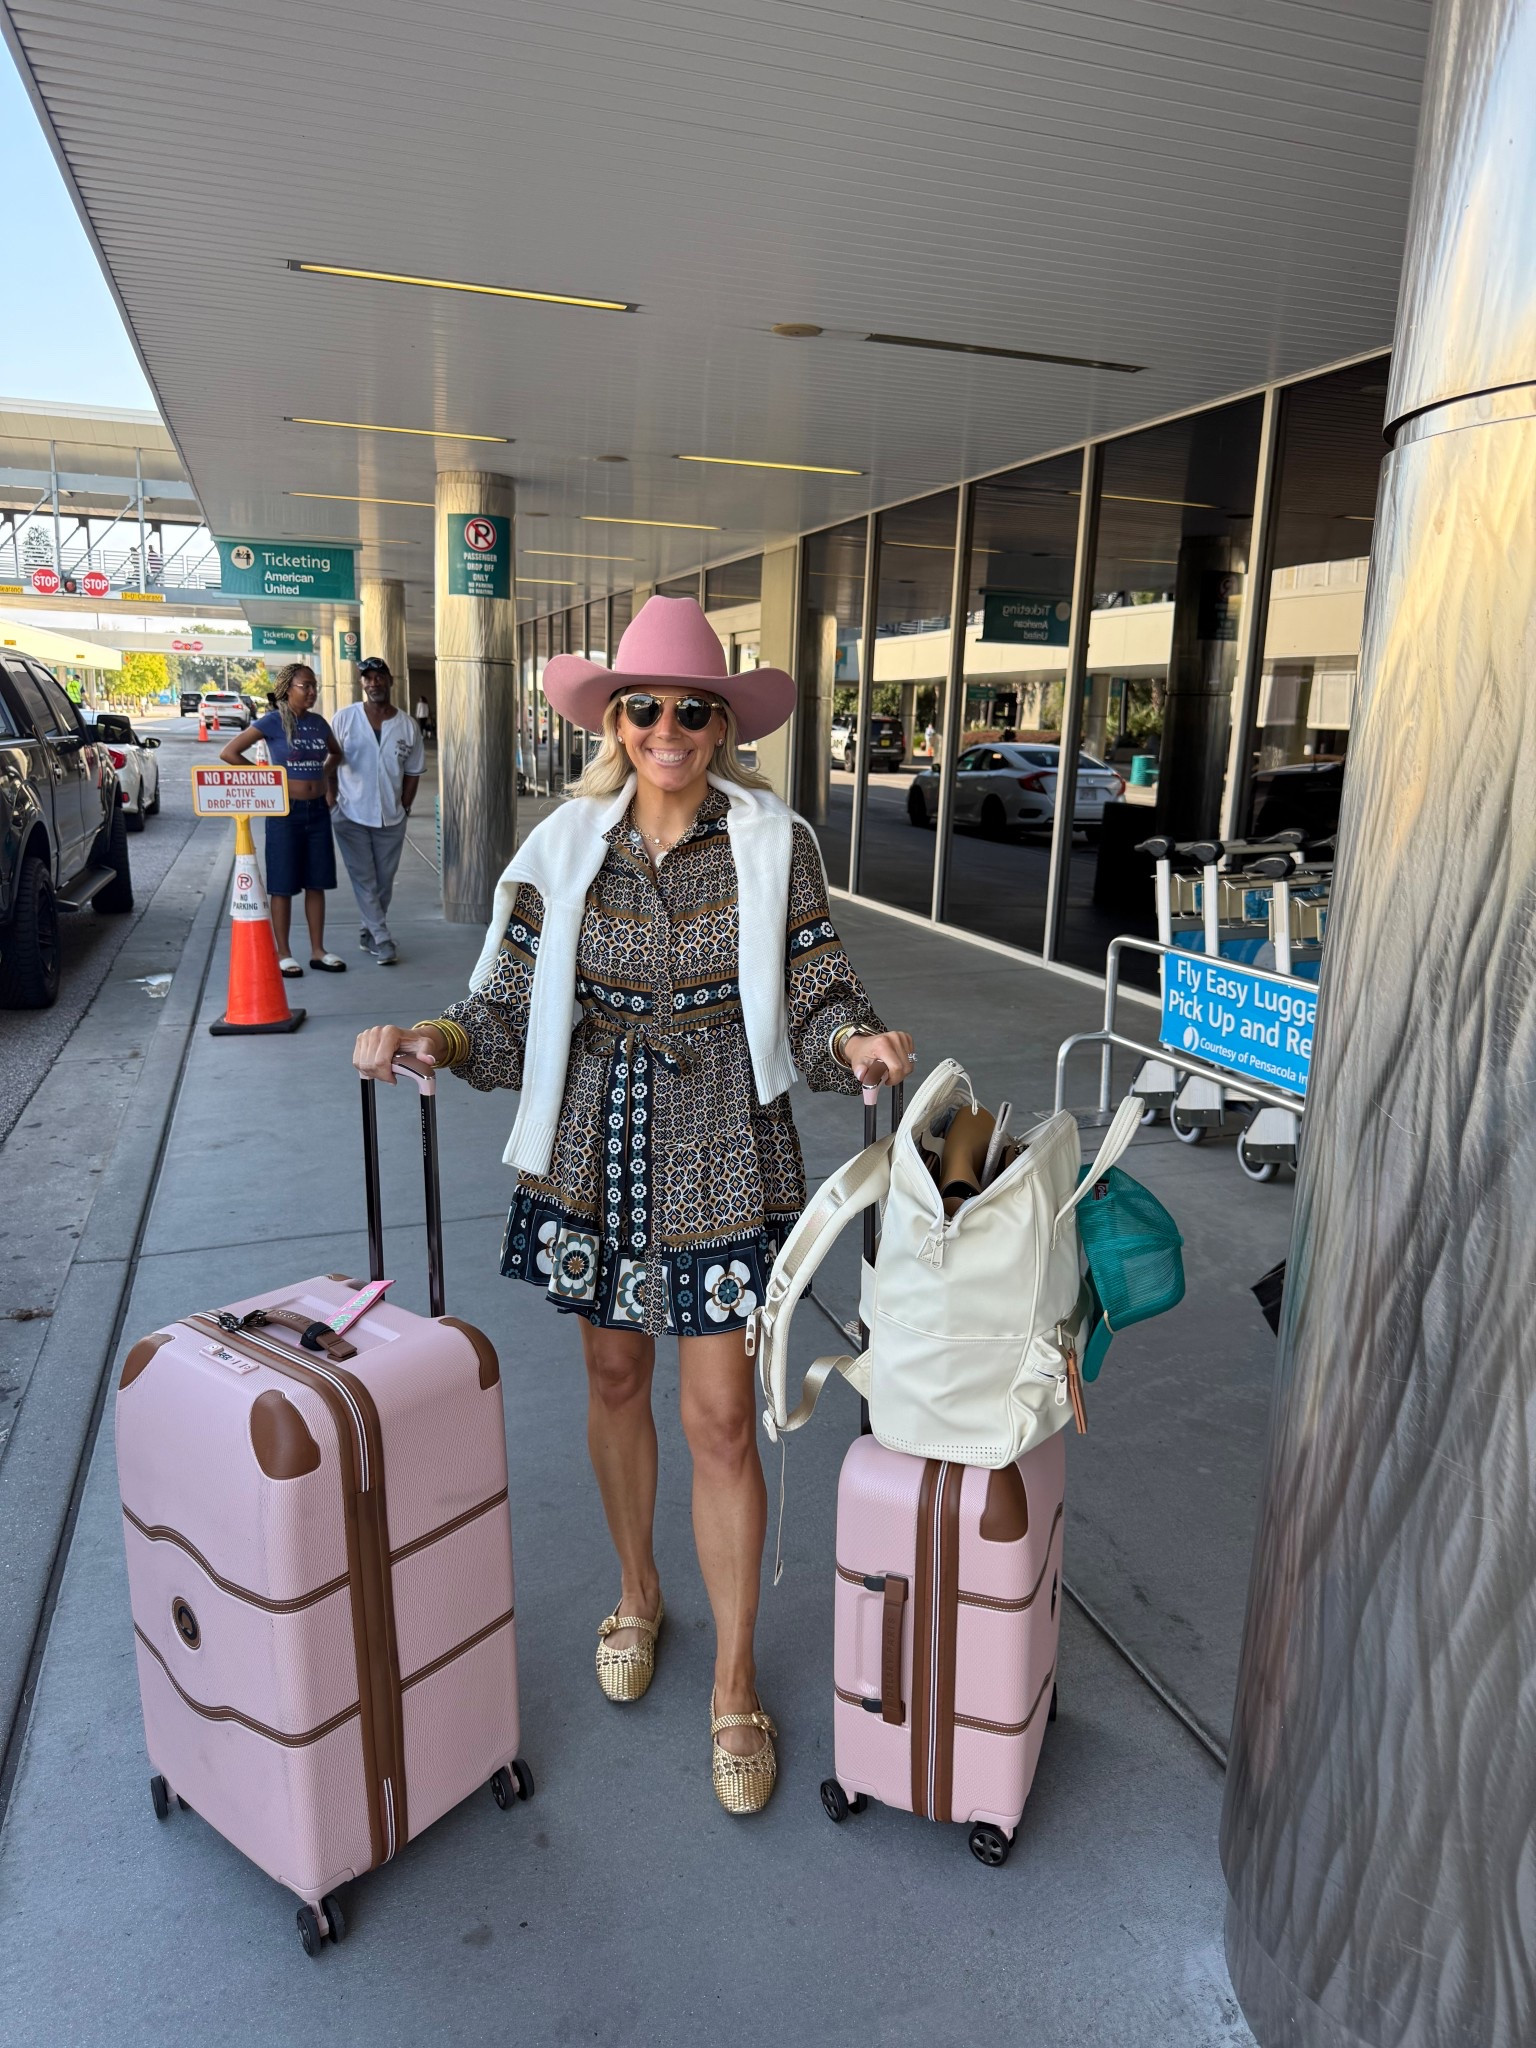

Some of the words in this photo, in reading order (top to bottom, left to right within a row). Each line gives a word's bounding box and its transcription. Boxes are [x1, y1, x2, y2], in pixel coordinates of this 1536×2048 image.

[262, 552, 330, 573] Ticketing
[463, 552, 497, 562] PASSENGER
[467, 562, 483, 571] DROP
[484, 563, 494, 572] OFF
[33, 575, 59, 587] STOP
[264, 571, 314, 583] American
[473, 573, 489, 582] ONLY
[84, 579, 108, 590] STOP
[264, 583, 299, 595] United
[262, 630, 295, 640] Ticketing
[203, 771, 220, 785] NO
[223, 771, 276, 785] PARKING
[226, 788, 256, 798] ACTIVE
[207, 799, 252, 809] DROP-OFF
[254, 799, 276, 809] ONLY
[233, 901, 259, 910] PARKING
[1177, 959, 1202, 994] Fly
[1206, 968, 1248, 1009] Easy
[1254, 981, 1318, 1027] Lugga
[1168, 989, 1204, 1023] Pick
[1208, 1001, 1236, 1038] Up
[1240, 1017, 1280, 1049] and
[1286, 1026, 1312, 1060] Re
[1199, 1037, 1237, 1062] Courtesy
[1237, 1050, 1249, 1063] of
[1249, 1053, 1296, 1082] Pensacola
[886, 1616, 897, 1652] PARIS
[886, 1658, 897, 1699] DELSEY
